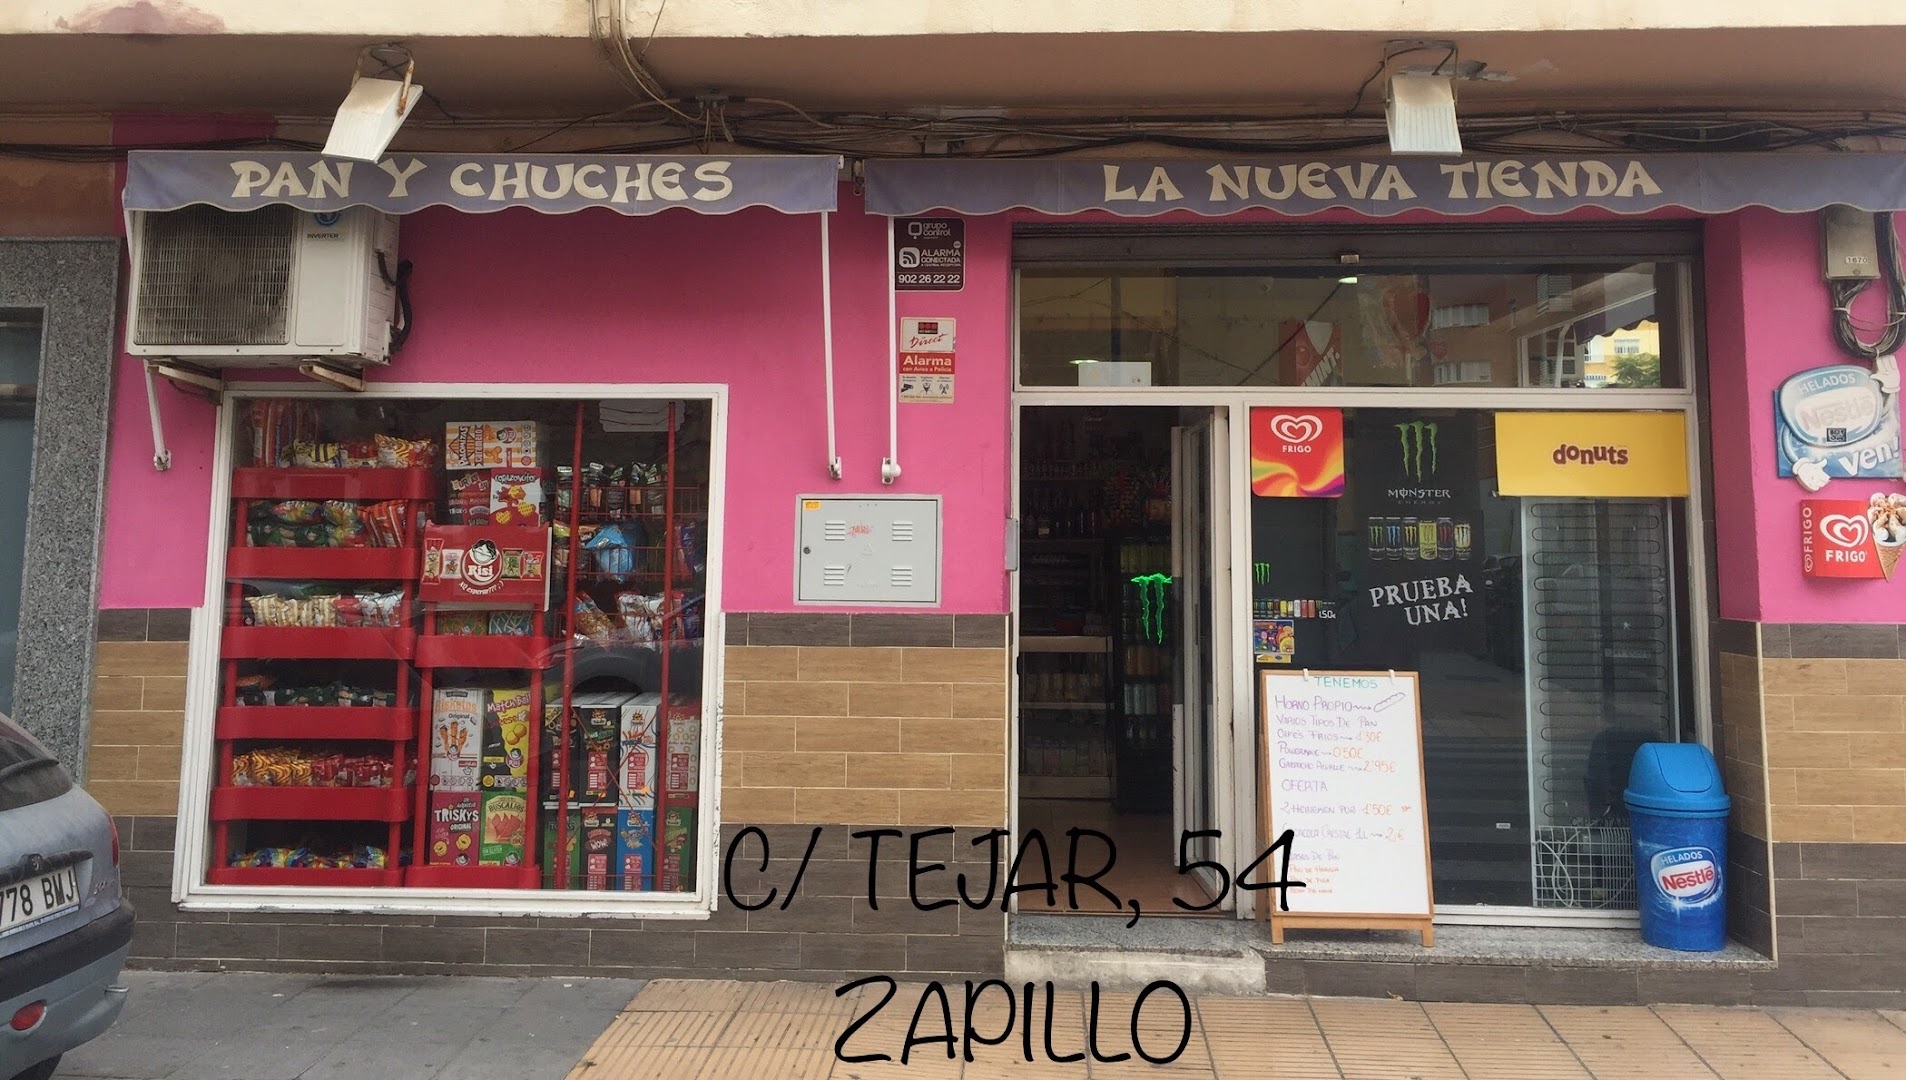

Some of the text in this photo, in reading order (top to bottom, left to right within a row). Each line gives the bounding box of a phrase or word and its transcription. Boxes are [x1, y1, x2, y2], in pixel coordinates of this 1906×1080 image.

[230, 158, 733, 203] PAN Y CHUCHES
[1103, 160, 1663, 202] LA NUEVA TIENDA
[898, 274, 960, 284] 902 26 22 22
[910, 333, 948, 348] Direct
[903, 355, 952, 366] Alarma
[1799, 374, 1856, 393] HELADOS
[1282, 445, 1312, 453] FRIGO
[1553, 444, 1628, 465] donuts
[1838, 436, 1899, 476] ven!
[1388, 488, 1451, 498] MONSTER
[1803, 506, 1813, 553] FRIGO
[1826, 550, 1867, 563] FRIGO
[468, 565, 493, 577] Risi
[1369, 573, 1473, 607] PRUEBA
[1404, 598, 1469, 626] UNA!
[1314, 676, 1378, 689] TENEMOS
[488, 699, 516, 712] Match
[1282, 778, 1328, 792] OFERTA
[1661, 851, 1703, 865] HELADOS
